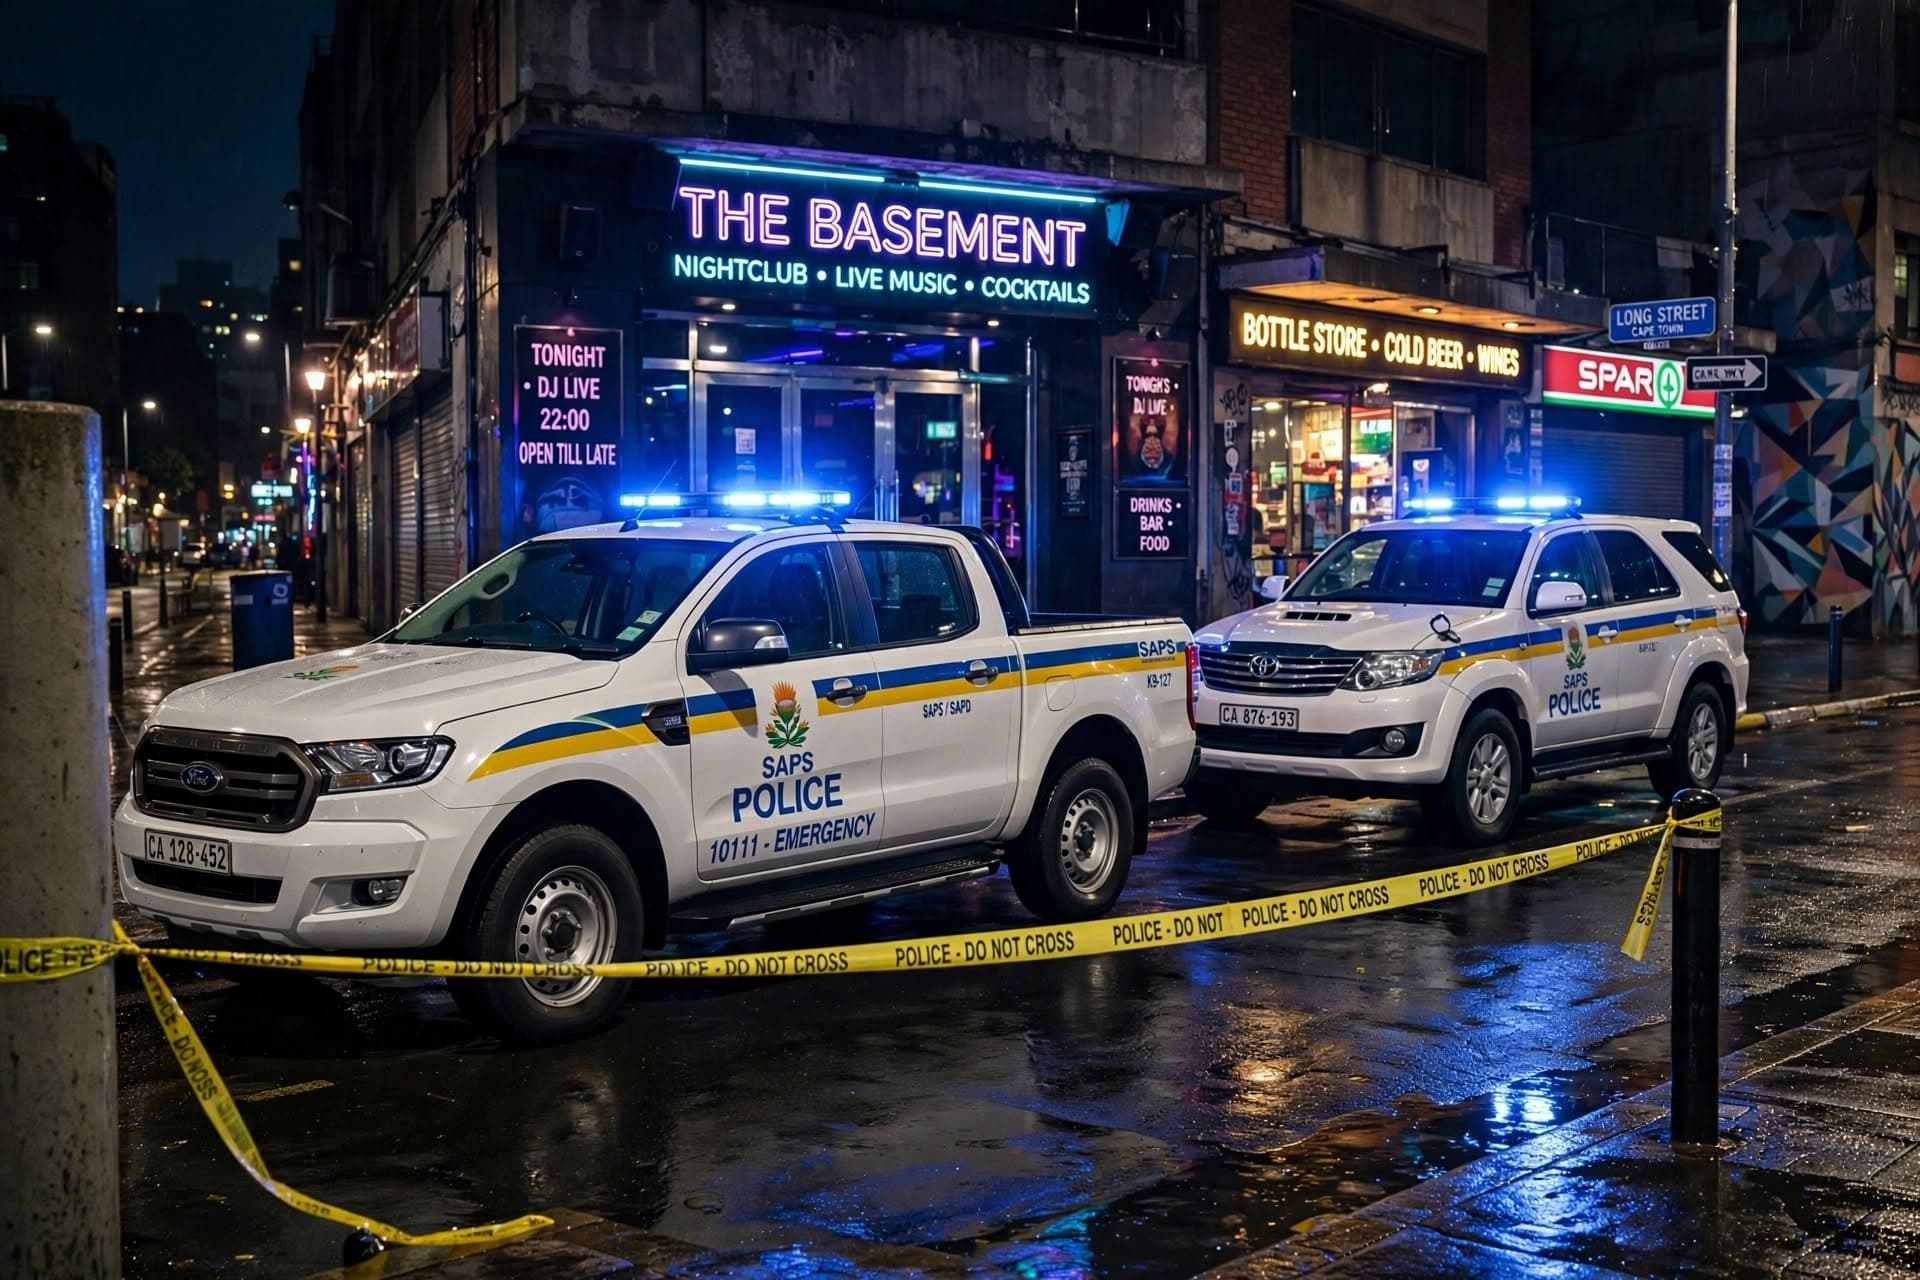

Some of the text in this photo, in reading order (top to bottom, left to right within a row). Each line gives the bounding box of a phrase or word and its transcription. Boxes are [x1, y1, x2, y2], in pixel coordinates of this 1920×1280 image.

[679, 187, 1086, 268] THE BASEMENT
[674, 254, 1090, 304] NIGHTCLUB LIVE MUSIC COCKTAILS
[1616, 303, 1708, 326] LONG STREET
[1631, 325, 1654, 338] CAPE
[531, 343, 606, 369] TONIGHT
[1243, 312, 1520, 377] BOTTLE STORE COLD BEER WINES
[537, 375, 601, 400] DJ LIVE
[1578, 359, 1653, 396] SPAR
[1133, 397, 1145, 414] DJ
[540, 408, 590, 431] 22:00
[519, 441, 617, 466] OPEN TILL LATE
[1130, 497, 1173, 513] DRINKS
[1139, 515, 1164, 531] BAR
[1139, 536, 1170, 551] FOOD
[1138, 638, 1176, 657] SAPS
[1563, 672, 1588, 690] SAPS
[922, 702, 944, 719] SAPS
[949, 699, 972, 715] SAPD
[1549, 687, 1601, 718] POLICE
[1222, 709, 1295, 727] CA 876-193
[762, 751, 814, 779] SAPS
[731, 773, 844, 823] POLICE
[710, 834, 758, 865] 10111
[774, 812, 876, 852] EMERGENCY
[1575, 839, 1610, 860] POLICE
[148, 835, 227, 871] CA 128-452
[1419, 871, 1461, 897] POLICE
[1469, 867, 1486, 887] DO
[1489, 862, 1510, 882] NOT
[1513, 853, 1549, 876] CROSS
[1241, 902, 1289, 928] POLICE
[1299, 898, 1317, 919] DO
[1321, 893, 1346, 915] NOT
[1348, 885, 1390, 911] CROSS
[1112, 920, 1163, 946] POLICE
[1173, 917, 1194, 938] DO
[1198, 912, 1224, 935] NOT
[0, 948, 52, 974] LICE
[895, 943, 951, 967] POLICE
[965, 939, 987, 961] DO
[992, 935, 1021, 959] NOT
[1025, 930, 1075, 955] CROSS
[362, 958, 436, 973] POLICE
[454, 962, 482, 975] DO
[489, 962, 524, 975] NOT
[533, 962, 594, 976] CROSS
[646, 961, 708, 977] POLICE
[726, 959, 750, 976] DO
[756, 955, 787, 976] NOT
[794, 952, 849, 974] CROSS
